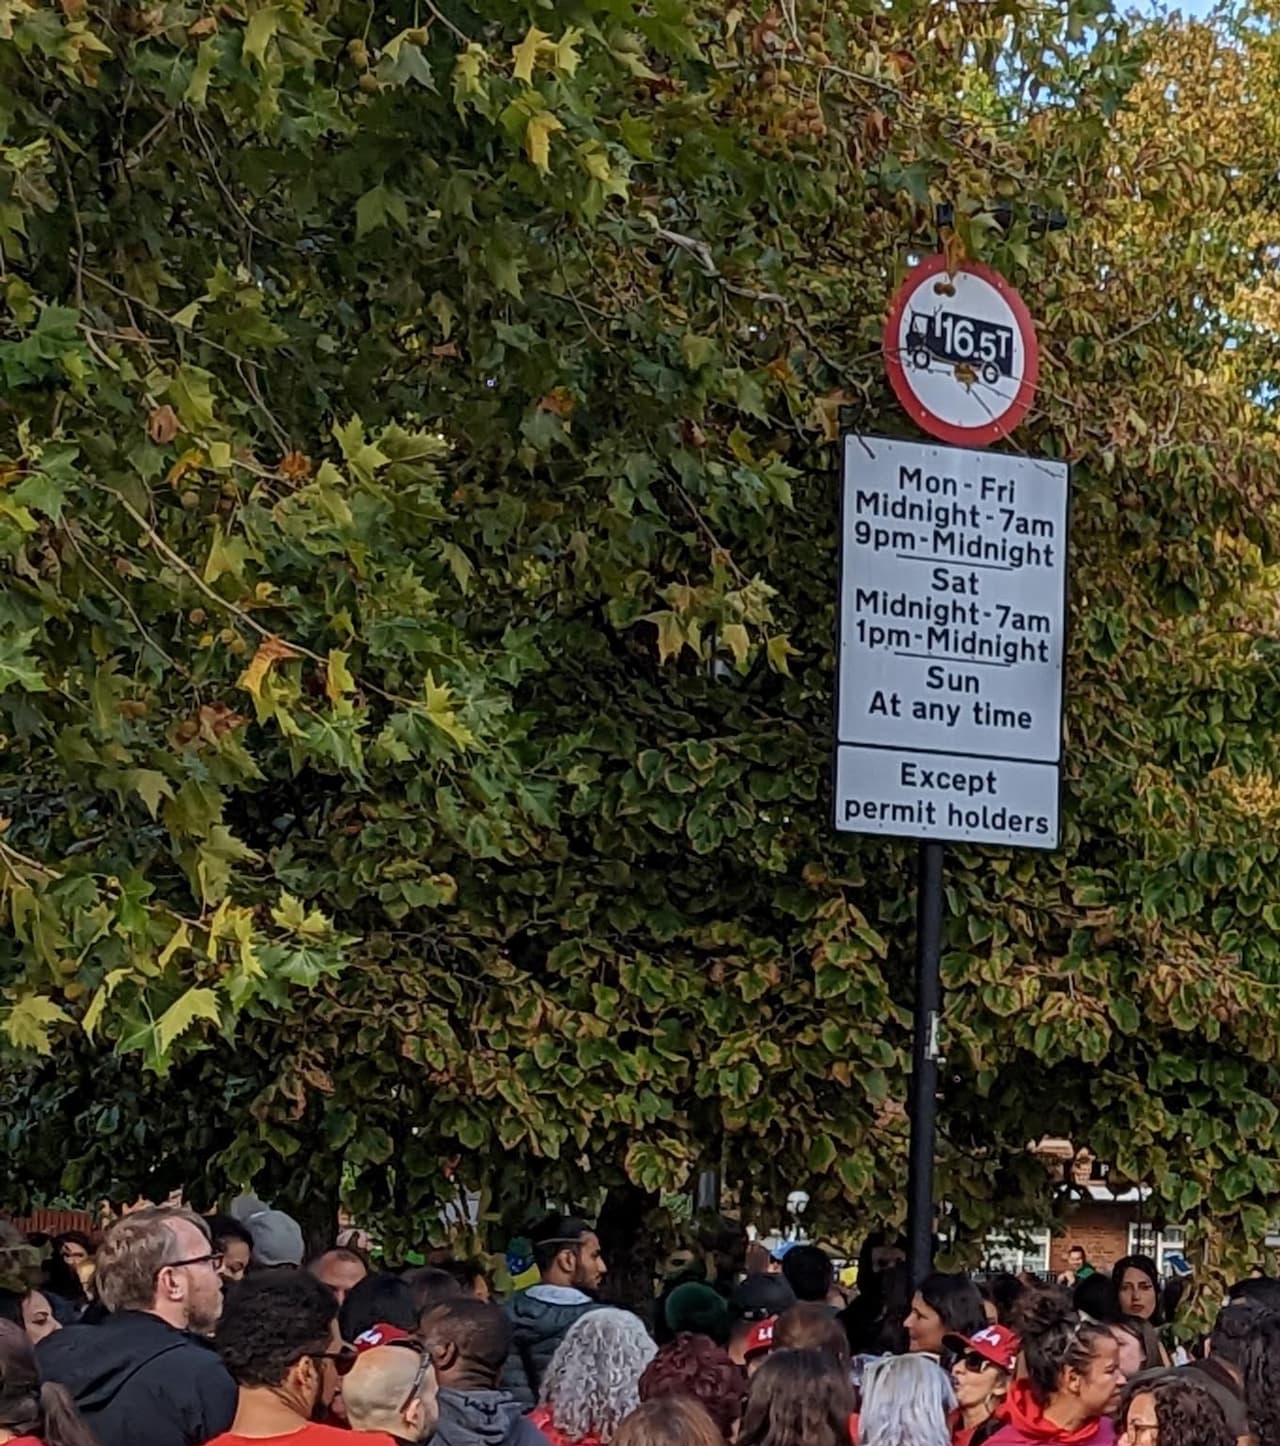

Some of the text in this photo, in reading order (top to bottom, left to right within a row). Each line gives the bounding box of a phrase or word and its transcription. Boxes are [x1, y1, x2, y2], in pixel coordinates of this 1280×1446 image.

[944, 315, 1012, 367] 16.5T
[899, 466, 957, 497] Mon
[980, 476, 1015, 504] Fri
[855, 490, 980, 529] Midnight
[999, 508, 1054, 538] 7am
[931, 567, 979, 597] Sat
[855, 588, 980, 627] Midnight
[997, 606, 1051, 634] 7am
[926, 665, 980, 695] Sun
[868, 691, 1033, 730] At any time
[900, 762, 998, 797] Except
[844, 798, 1050, 835] permit holders
